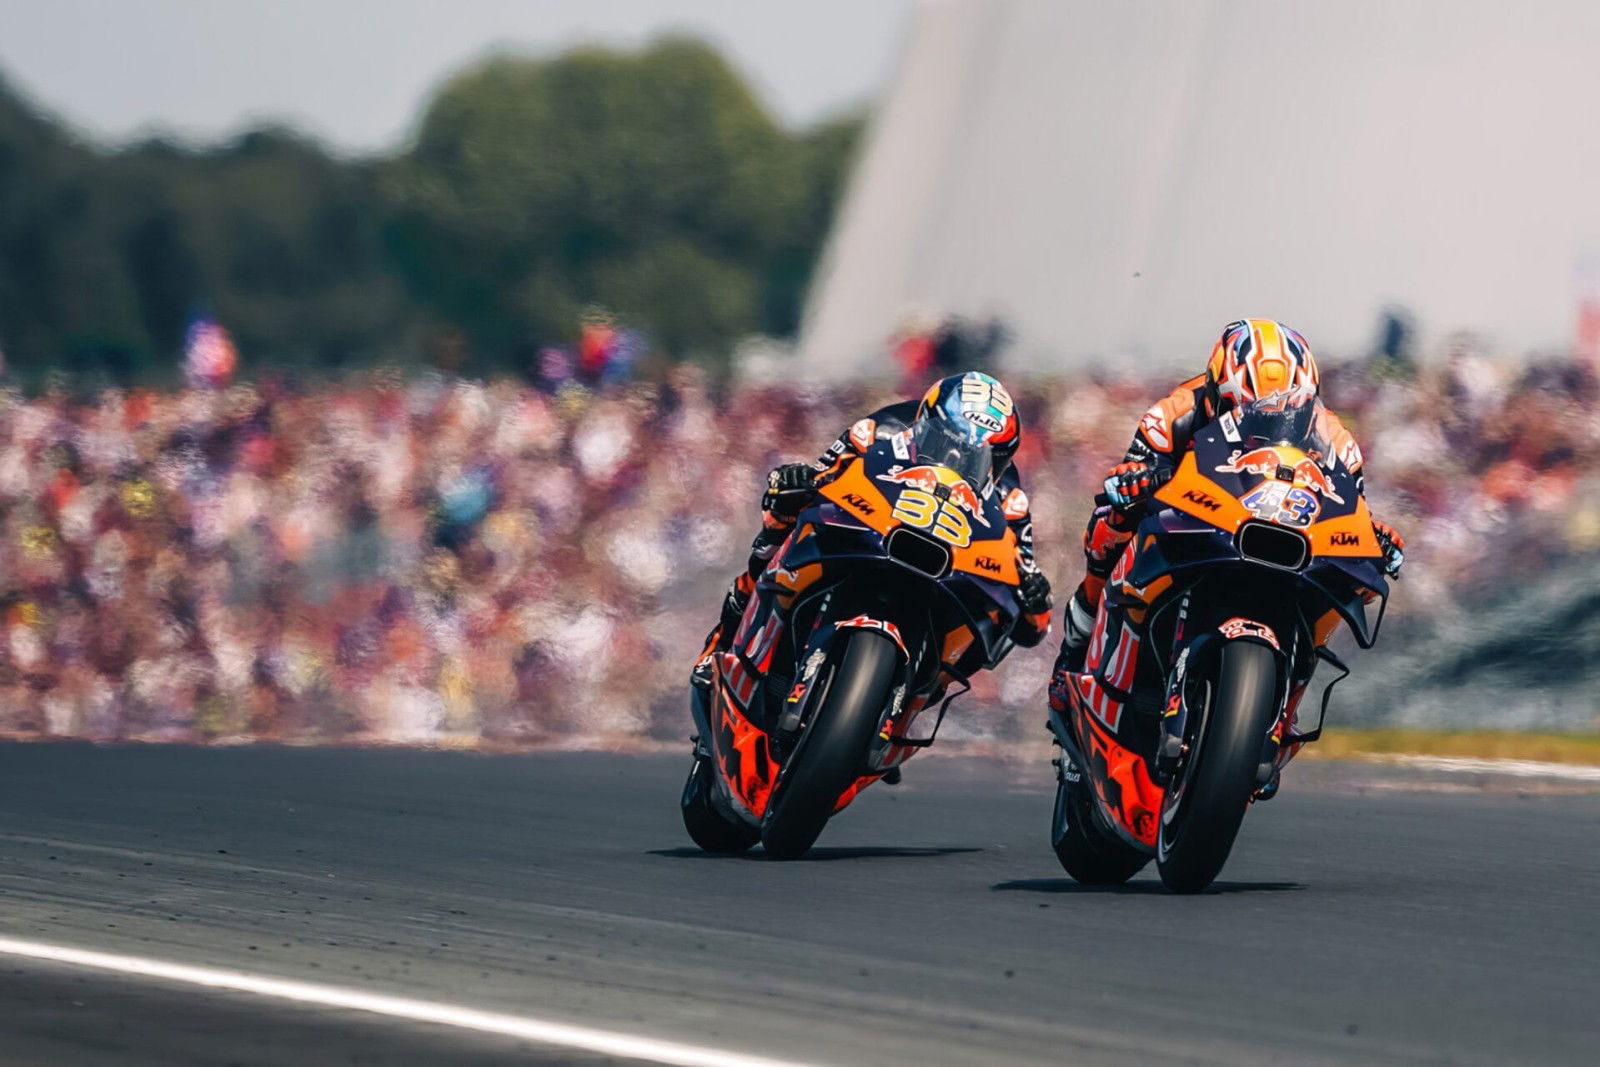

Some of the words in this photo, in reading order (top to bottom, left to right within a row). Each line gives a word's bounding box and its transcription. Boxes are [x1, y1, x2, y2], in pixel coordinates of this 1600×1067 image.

[961, 379, 1014, 416] 33
[968, 412, 1000, 430] HJC
[841, 493, 875, 516] KTM
[1182, 490, 1222, 512] KTM
[1241, 480, 1319, 529] 43
[892, 489, 973, 548] 33
[1330, 531, 1360, 547] KTM
[974, 556, 1002, 574] KTM
